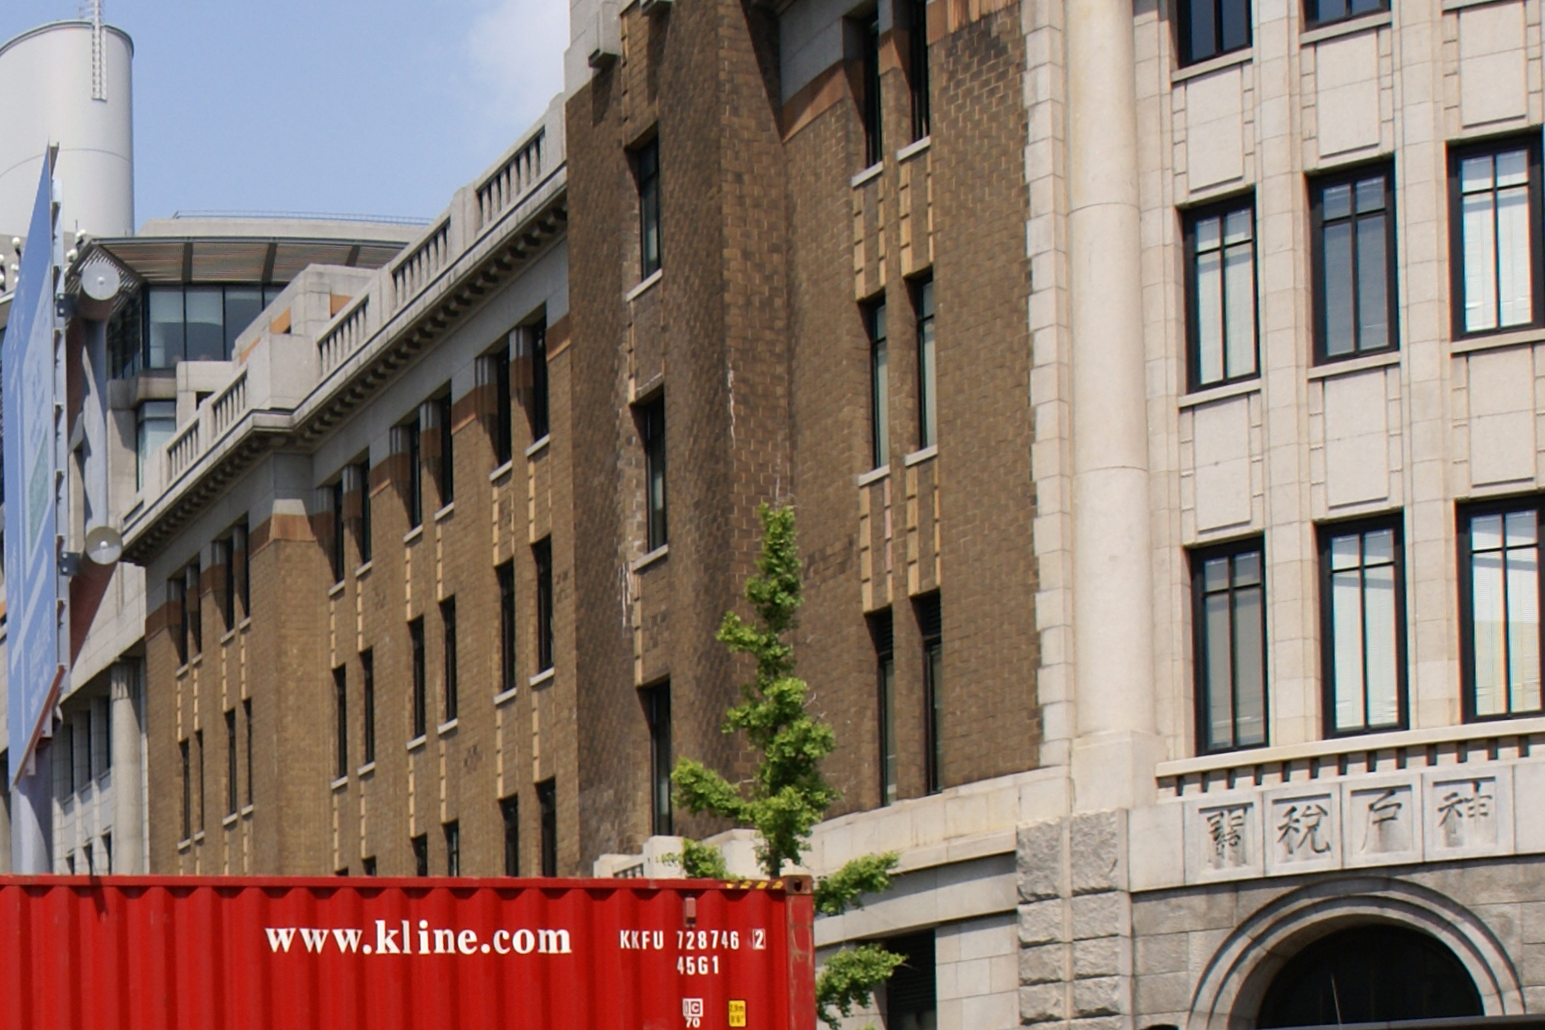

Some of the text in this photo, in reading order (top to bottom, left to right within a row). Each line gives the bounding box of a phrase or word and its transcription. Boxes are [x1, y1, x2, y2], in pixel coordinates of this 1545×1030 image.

[265, 919, 572, 955] www.kline.com
[619, 929, 765, 950] KKFU 728746 2
[676, 955, 719, 976] 45G1
[685, 1017, 701, 1028] 70
